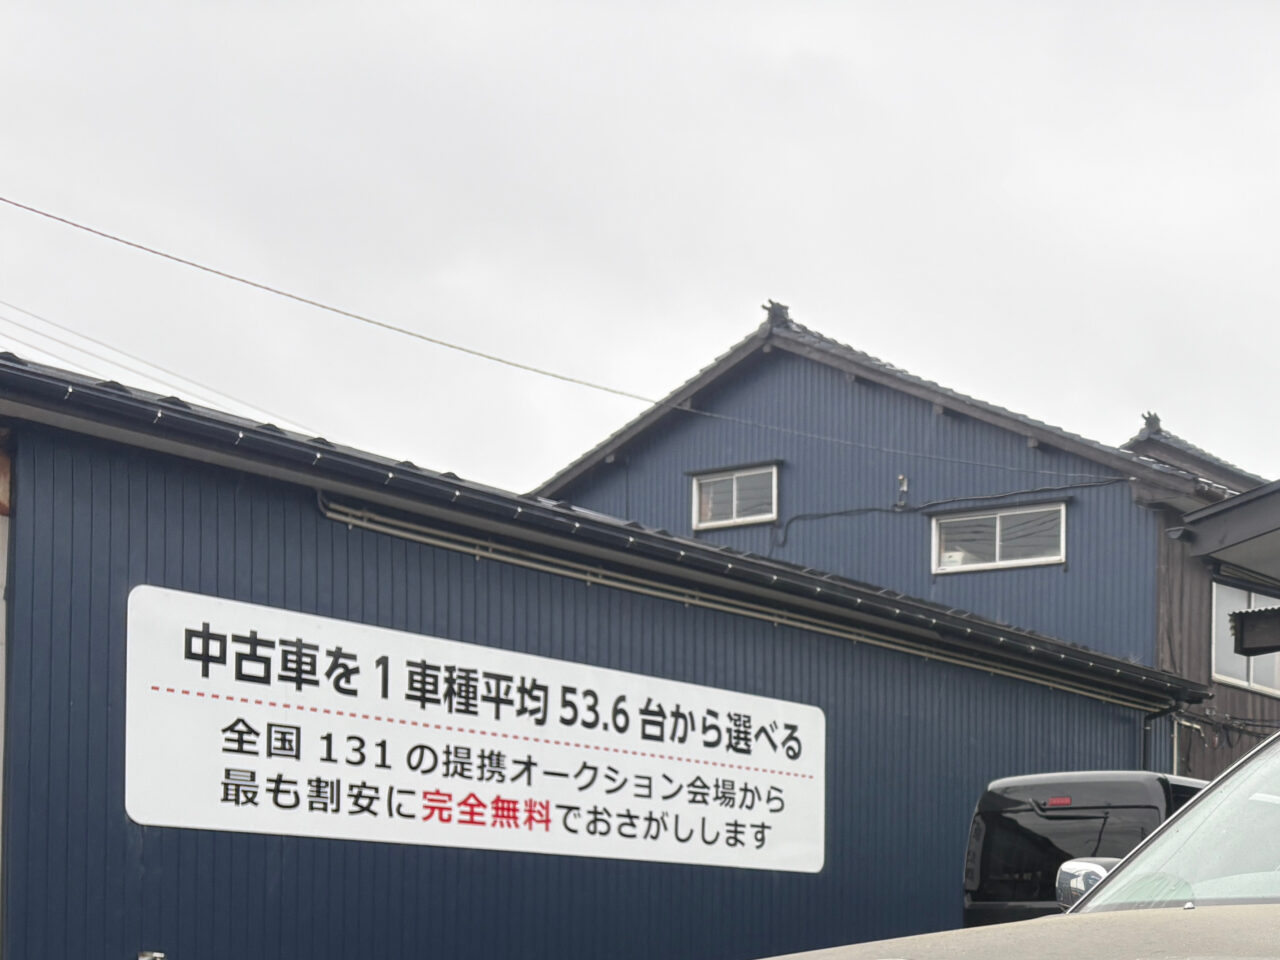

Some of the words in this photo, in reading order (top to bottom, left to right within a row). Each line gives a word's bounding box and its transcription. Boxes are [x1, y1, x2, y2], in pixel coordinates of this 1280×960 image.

[220, 768, 773, 850] 最も割安に完全無料でおさがしします
